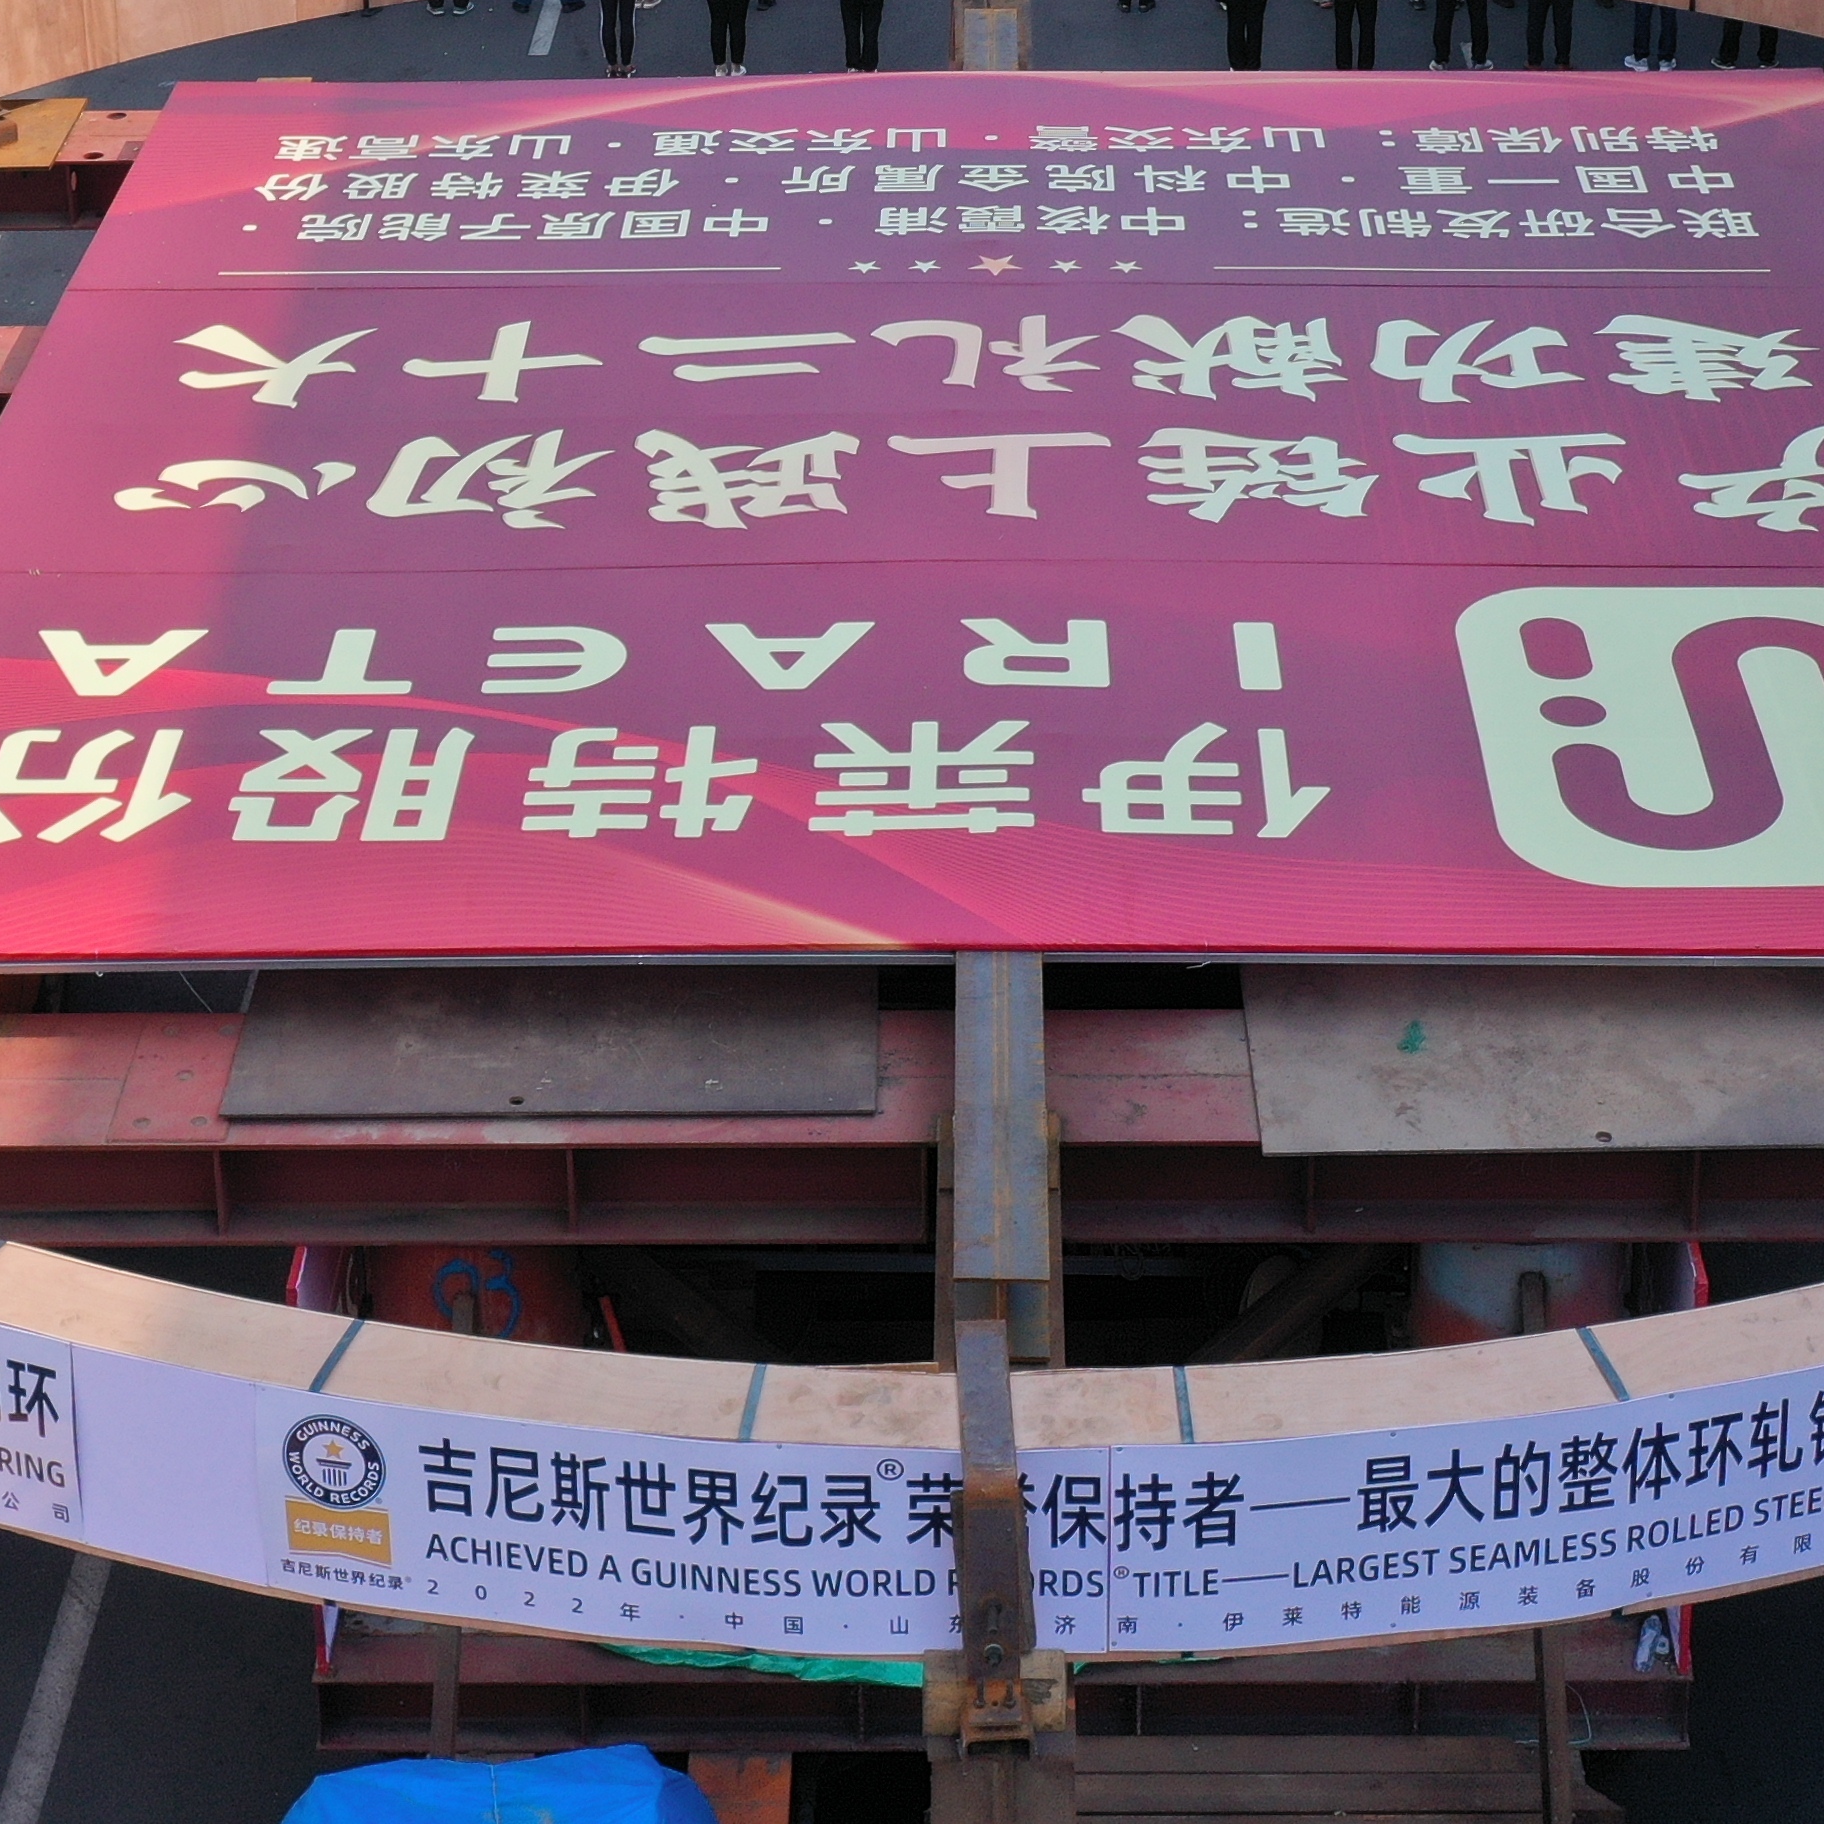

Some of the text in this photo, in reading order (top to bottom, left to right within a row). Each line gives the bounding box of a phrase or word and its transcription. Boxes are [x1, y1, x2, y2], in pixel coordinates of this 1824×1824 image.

[174, 315, 1818, 408] 建功献礼二十大
[296, 1420, 371, 1451] GUINNESS
[288, 1451, 325, 1498] WORLD
[329, 1461, 381, 1504] RECORDS
[293, 1517, 384, 1546] 纪录保持者
[425, 1534, 589, 1580] ACHIEVED
[597, 1554, 623, 1583] A
[629, 1556, 802, 1598] GUINNESS
[810, 1567, 936, 1598] WORLD
[1448, 1529, 1618, 1574] SEAMLESS
[1626, 1504, 1744, 1554] ROLLED
